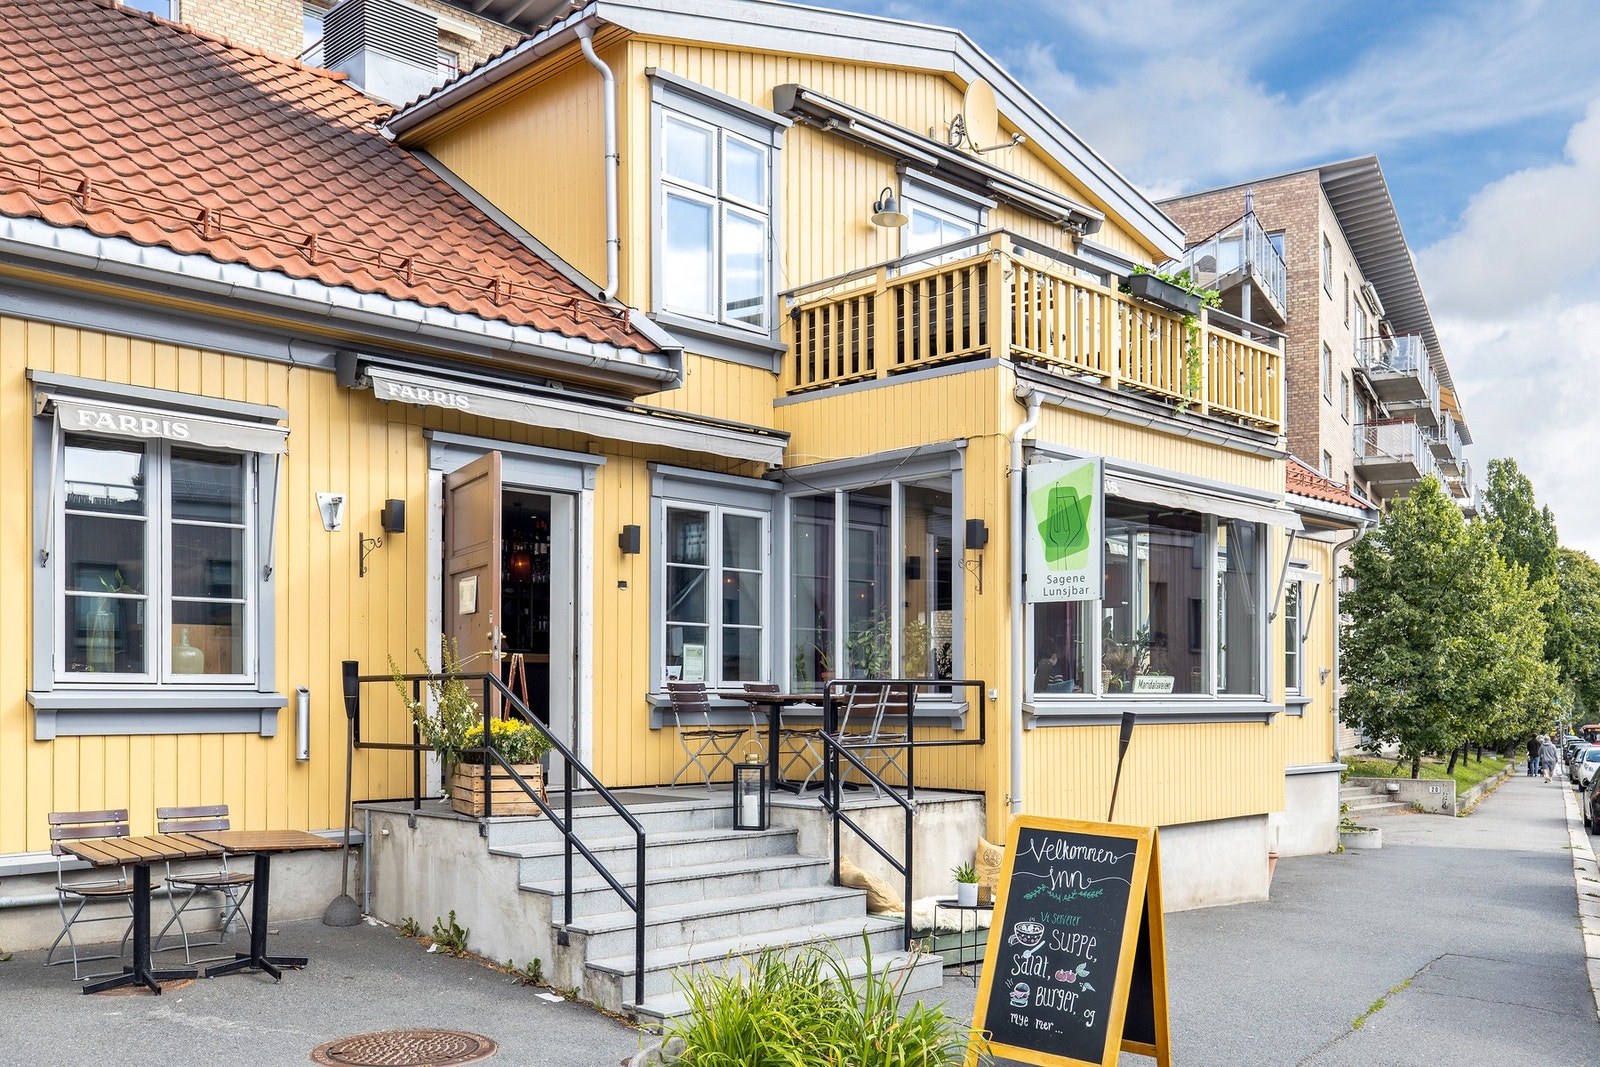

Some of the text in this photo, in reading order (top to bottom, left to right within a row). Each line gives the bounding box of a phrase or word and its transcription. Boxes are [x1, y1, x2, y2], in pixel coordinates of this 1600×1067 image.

[386, 382, 470, 409] FARRIS
[78, 409, 190, 438] FARRIS
[1046, 574, 1086, 586] Sagene
[1043, 586, 1089, 598] Lunsjbar
[1030, 837, 1118, 865] Velkommen
[1011, 953, 1051, 981] Salat,
[1010, 1012, 1029, 1027] mye
[1083, 1009, 1096, 1027] og
